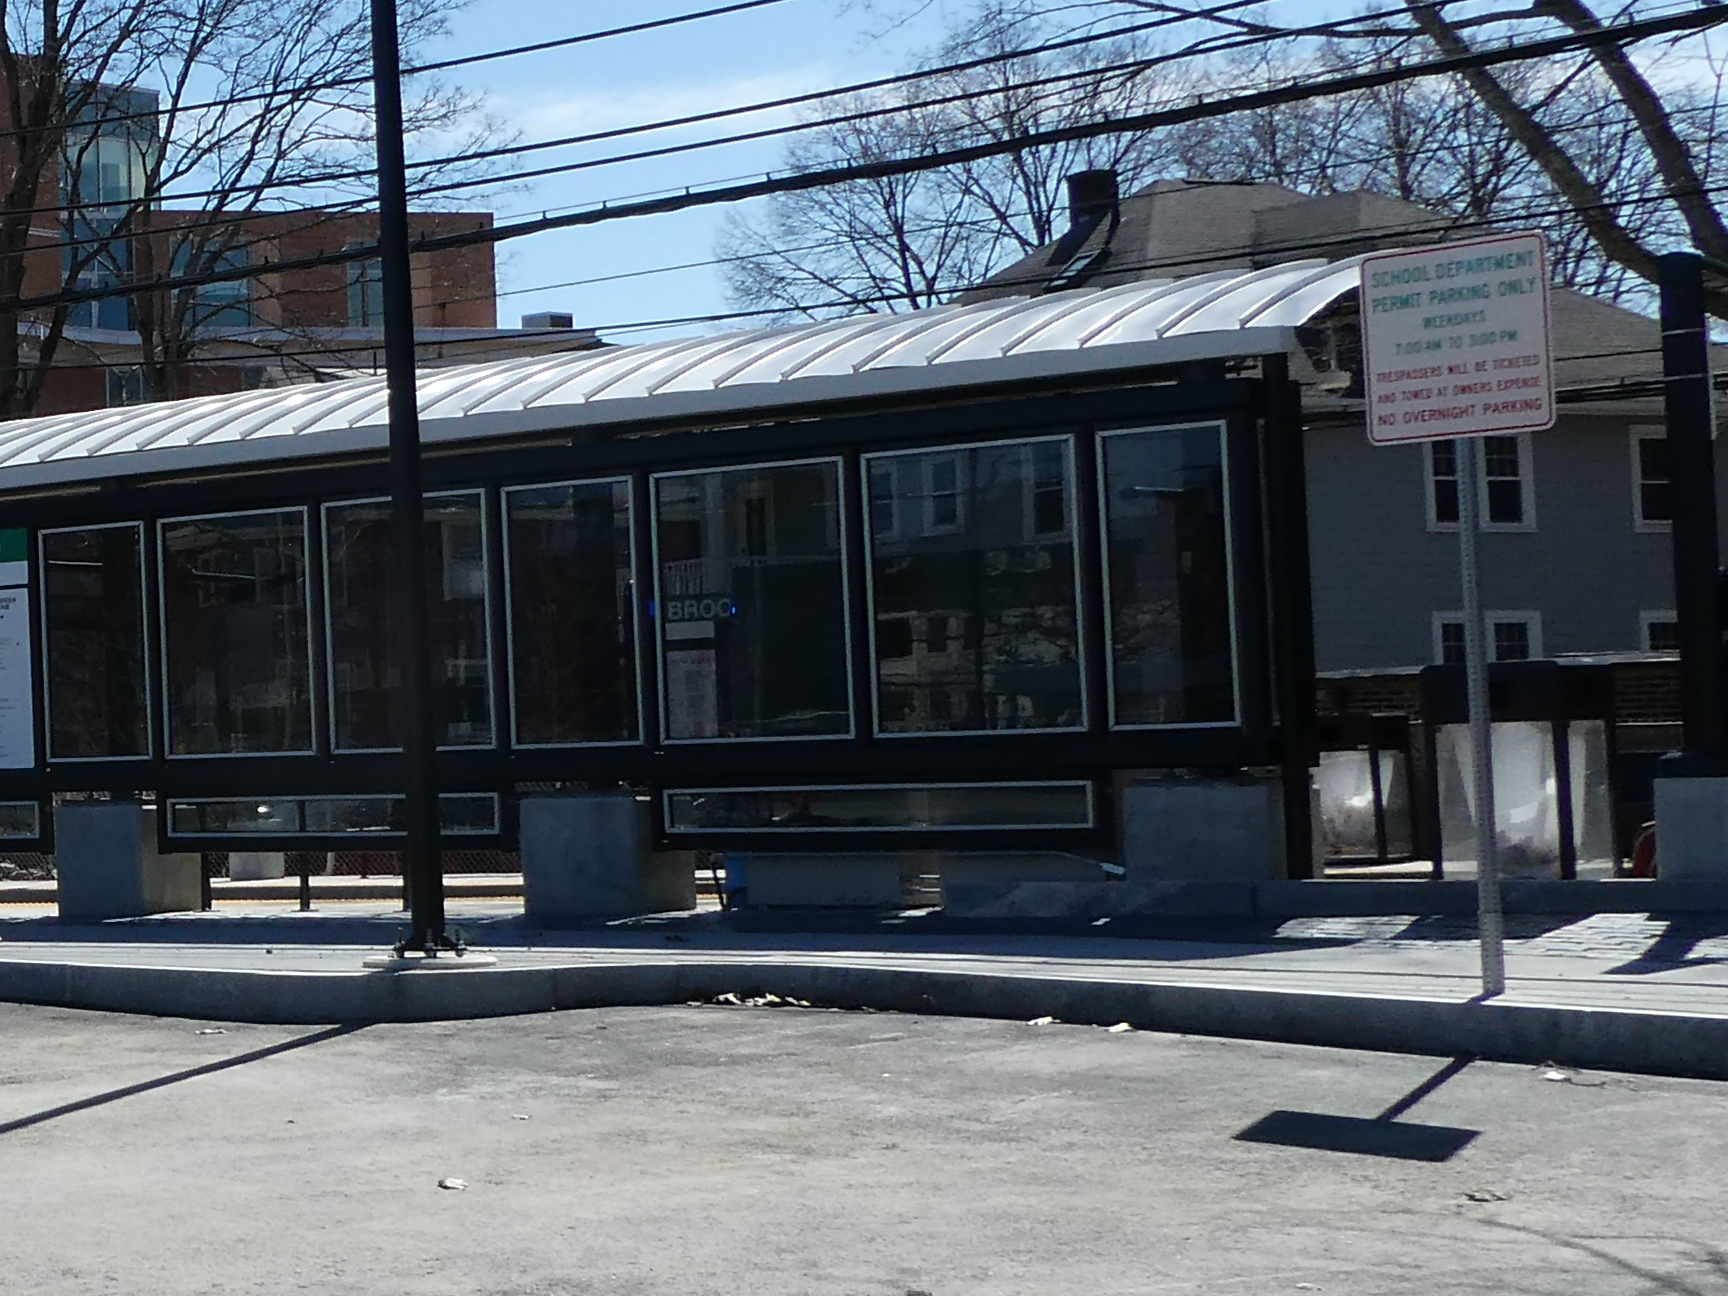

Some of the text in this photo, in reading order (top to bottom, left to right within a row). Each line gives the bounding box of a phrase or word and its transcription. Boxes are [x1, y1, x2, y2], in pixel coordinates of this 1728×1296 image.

[1372, 251, 1534, 288] SCHOOL DEPARTMENT
[1372, 276, 1536, 313] PERMIT PARKING ONLY
[1422, 310, 1486, 329] WEEKDAYS
[1425, 339, 1442, 351] AM
[1448, 335, 1463, 349] TO
[1499, 330, 1518, 343] PM
[1377, 355, 1540, 383] TRESPASSERS WILL BE TICKETED
[1377, 376, 1541, 404] AND TOWED AT OWNERS EXPENSE
[1378, 397, 1543, 426] NO OVERNIGHT PARKING
